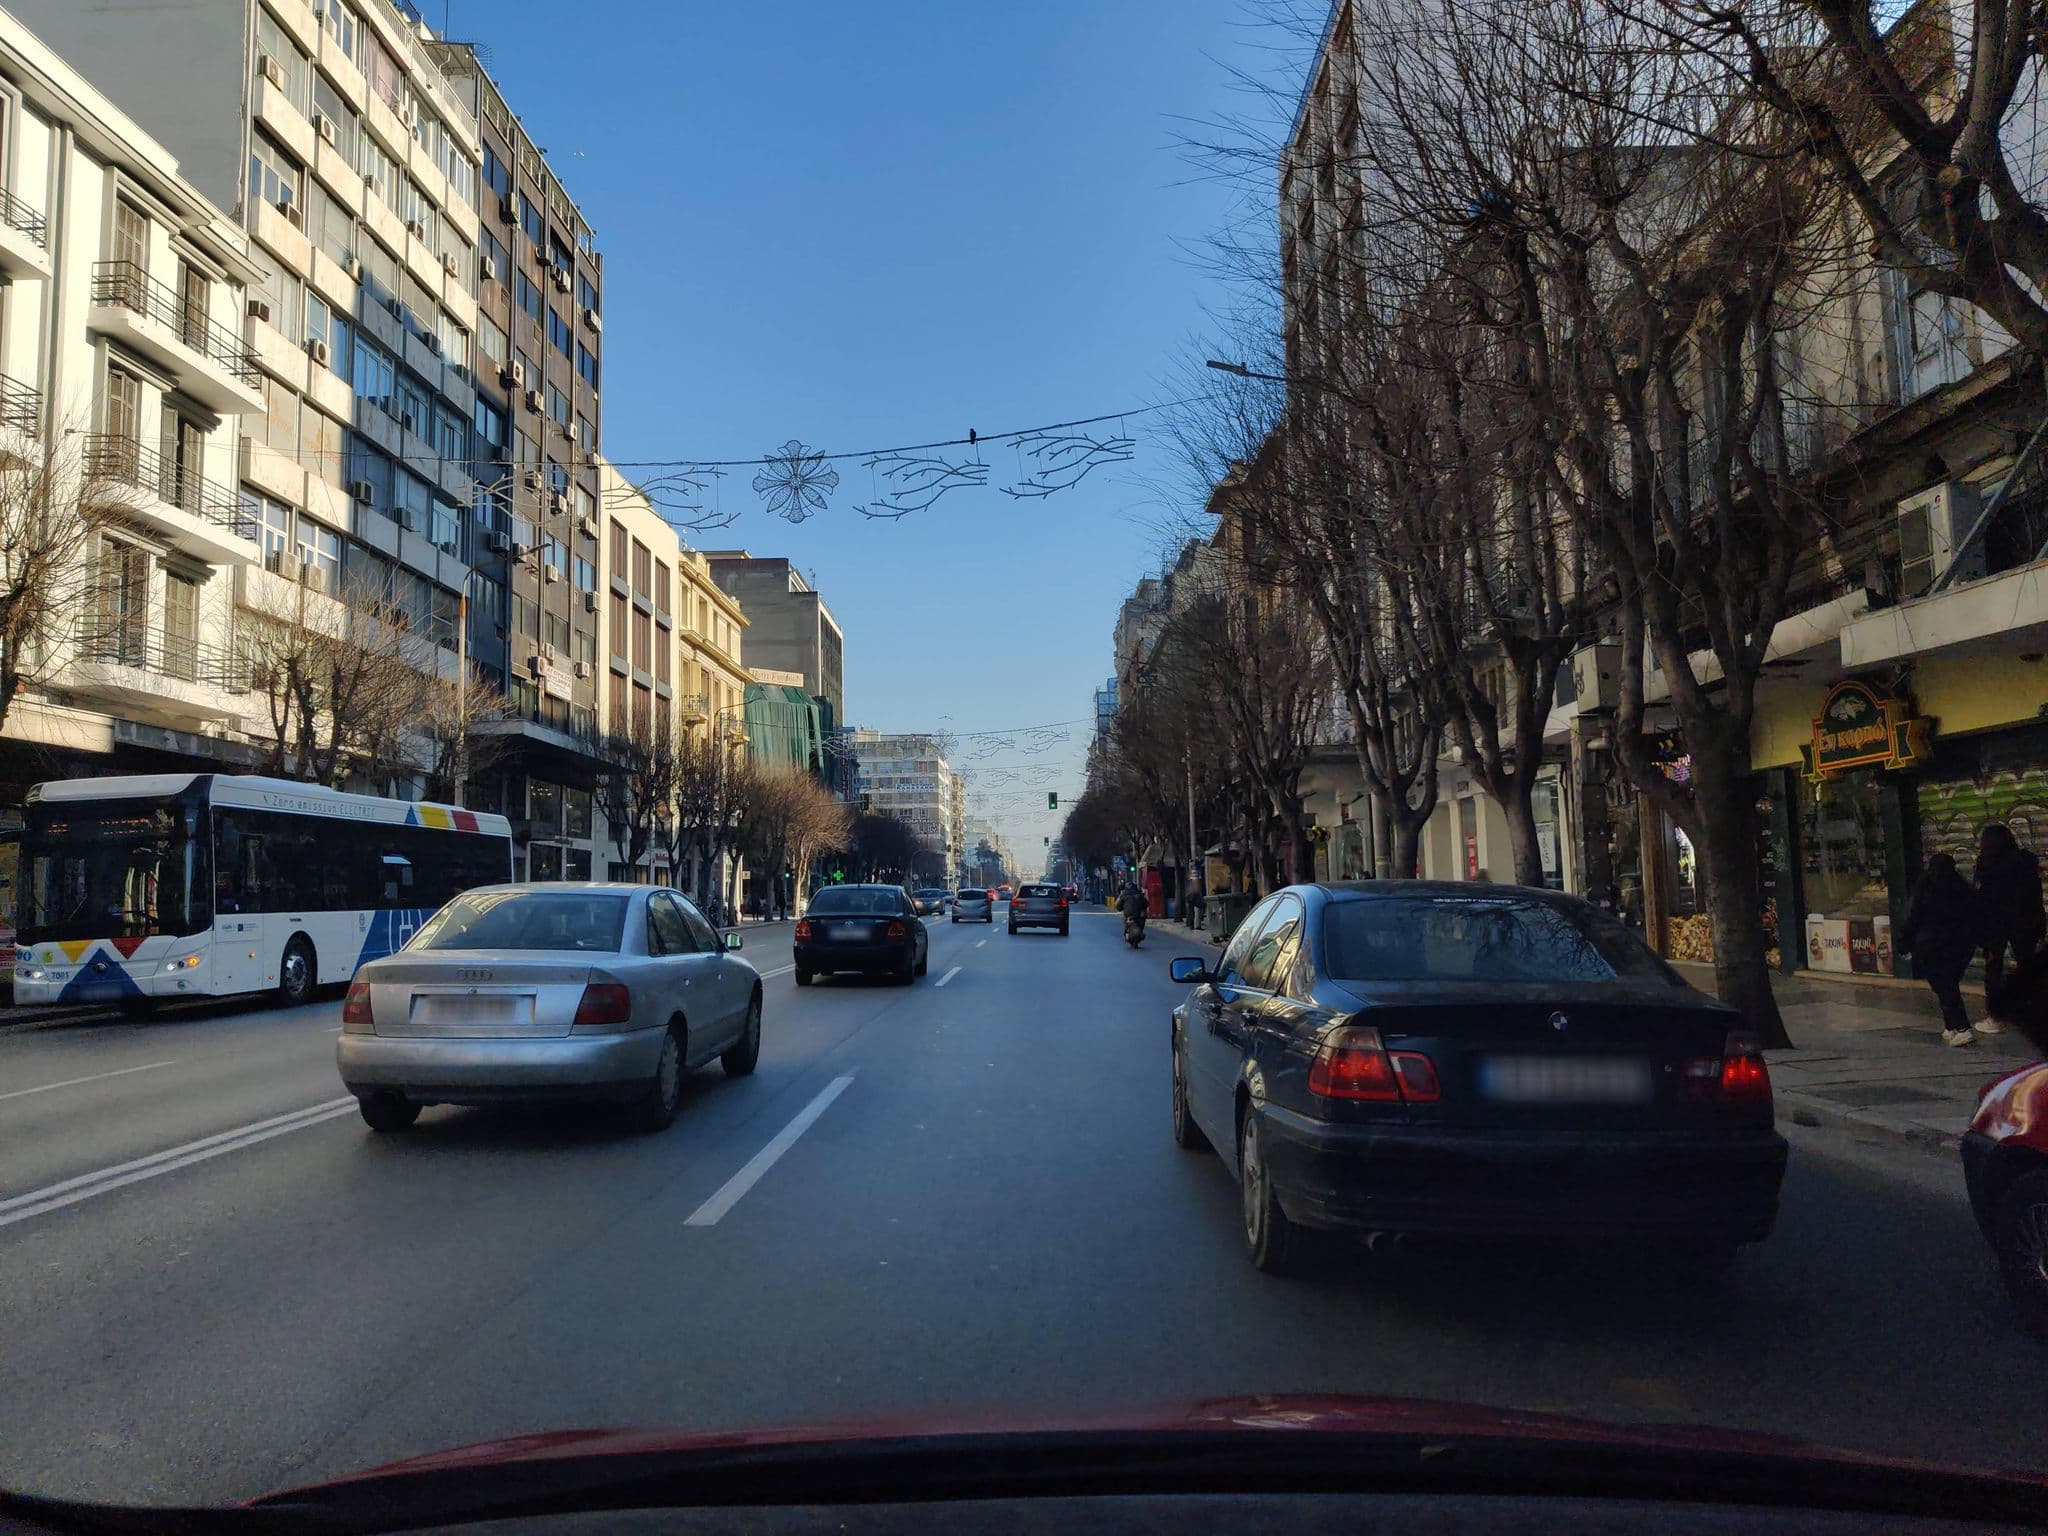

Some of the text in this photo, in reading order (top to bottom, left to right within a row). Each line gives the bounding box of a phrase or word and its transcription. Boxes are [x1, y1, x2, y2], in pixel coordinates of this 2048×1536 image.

[273, 794, 376, 817] Zero emission ELECTRIC
